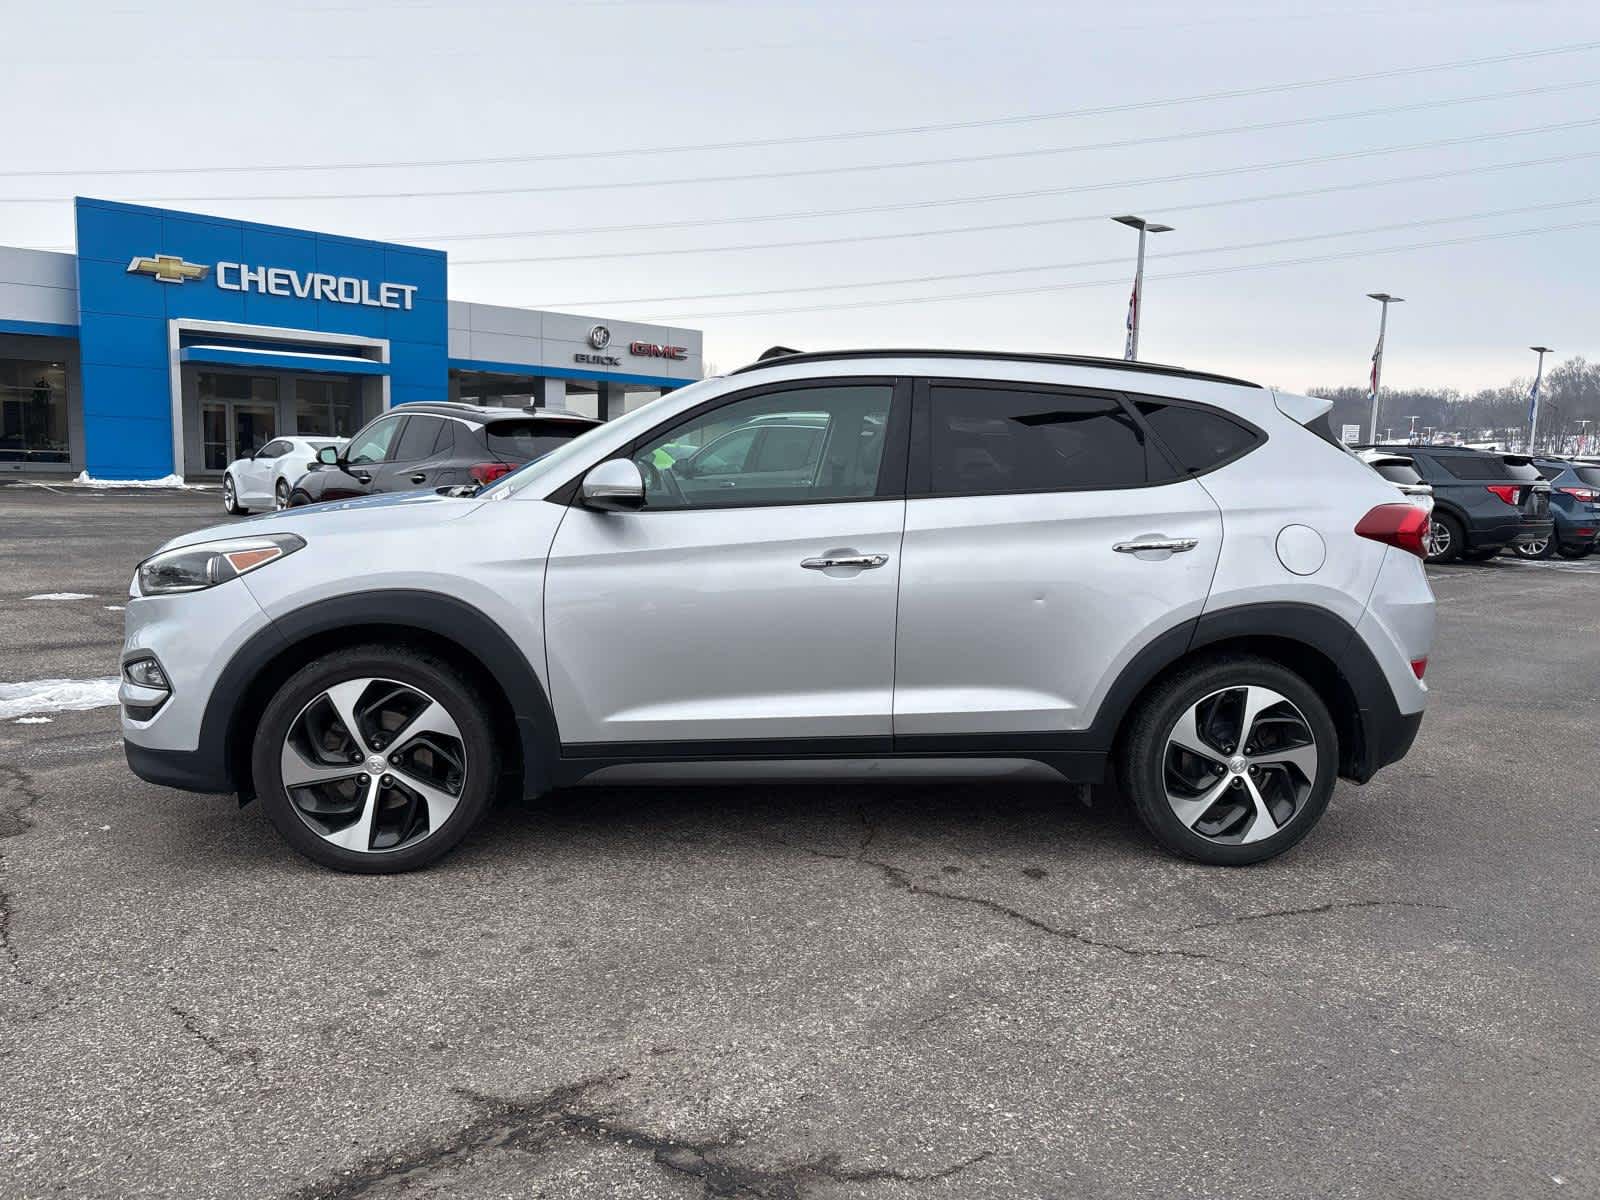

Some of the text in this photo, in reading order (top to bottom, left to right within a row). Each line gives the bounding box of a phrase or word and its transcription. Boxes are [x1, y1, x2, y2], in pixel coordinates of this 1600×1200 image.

[216, 261, 418, 310] CHEVROLET
[575, 353, 621, 366] BUICK
[630, 341, 688, 360] GMC
